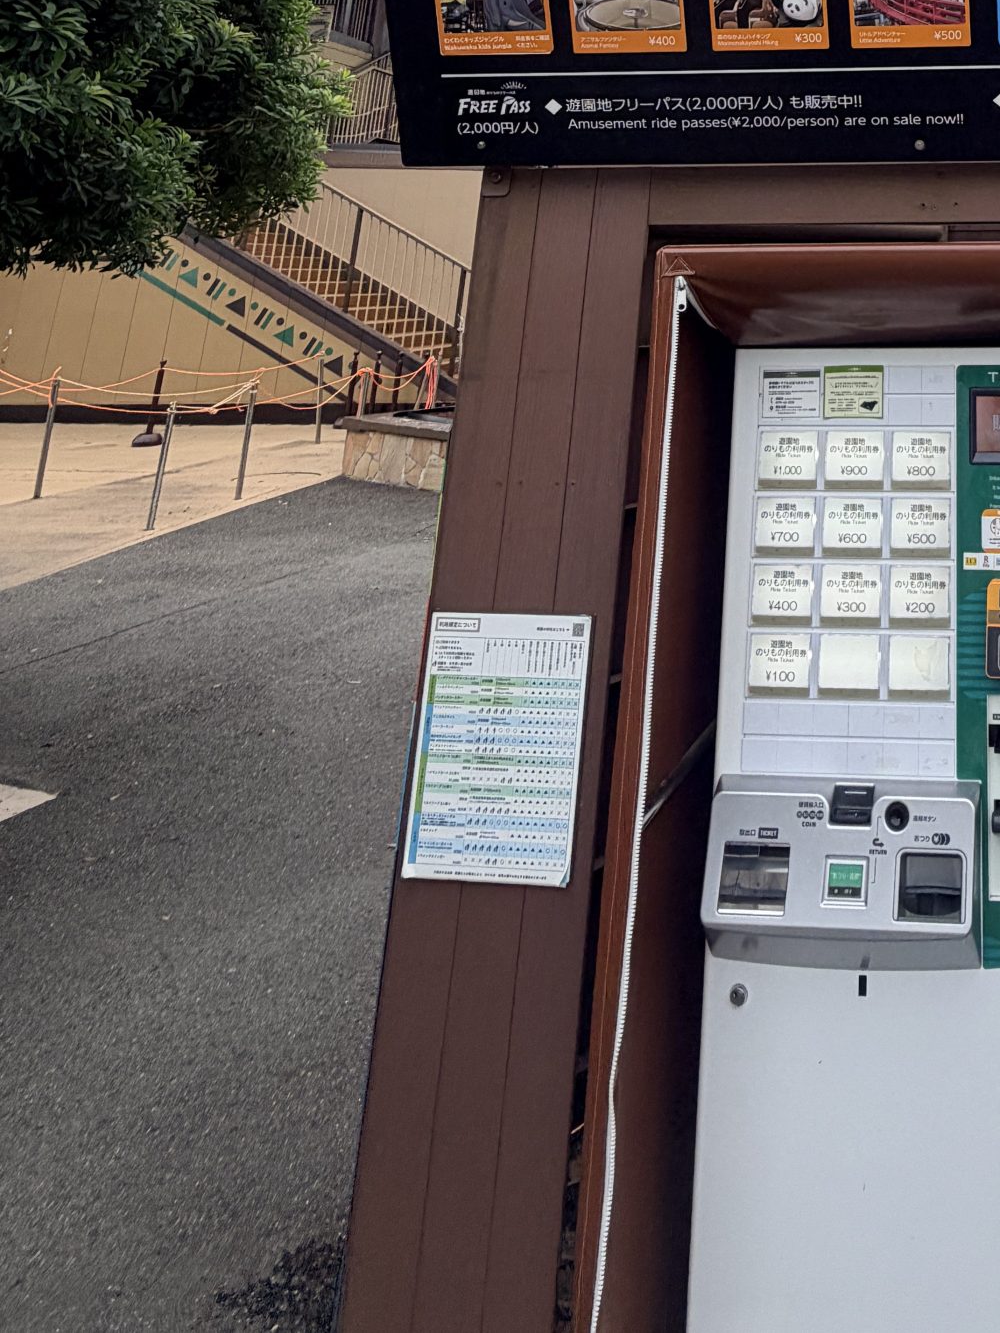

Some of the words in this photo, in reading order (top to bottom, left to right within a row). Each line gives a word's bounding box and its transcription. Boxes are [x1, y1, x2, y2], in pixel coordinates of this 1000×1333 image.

[648, 35, 676, 46] ¥400
[794, 33, 822, 44] ¥300
[934, 30, 962, 41] ¥500
[457, 98, 498, 116] FREE
[500, 96, 531, 115] PASS
[790, 94, 863, 110] も販売中!!
[568, 118, 647, 130] Amusement
[651, 117, 677, 129] ride
[844, 116, 866, 126] are
[871, 116, 889, 126] on
[893, 114, 921, 126] sale
[926, 113, 964, 125] now!!
[457, 121, 539, 135] (2,000円/人)
[773, 465, 803, 475] ¥1,000
[840, 465, 868, 476] ¥900
[906, 466, 936, 476] ¥800
[770, 531, 800, 542] ¥700
[838, 533, 867, 544] ¥600
[906, 533, 937, 544] ¥500
[768, 600, 798, 612] ¥400
[836, 602, 866, 613] ¥300
[905, 602, 935, 614] ¥200
[765, 670, 796, 682] ¥100
